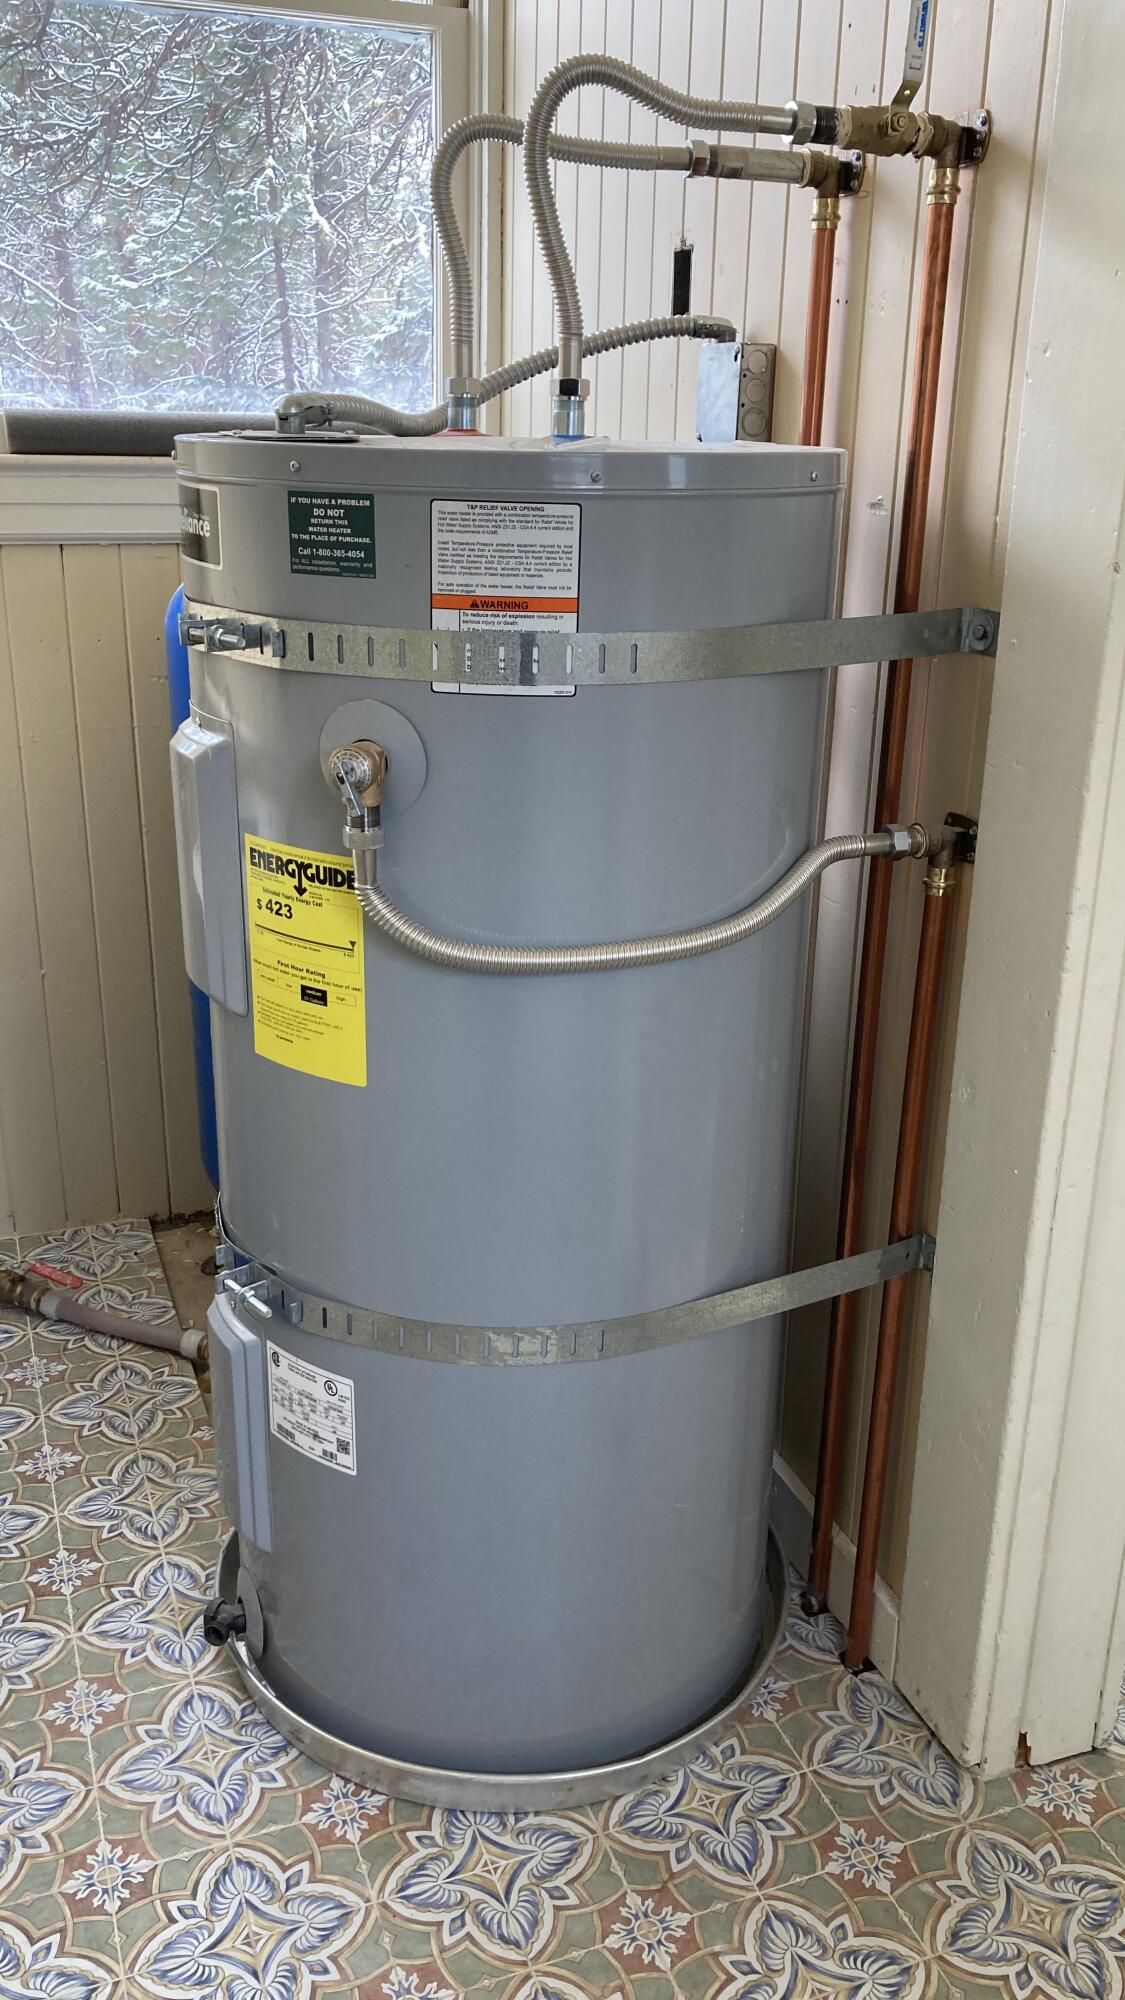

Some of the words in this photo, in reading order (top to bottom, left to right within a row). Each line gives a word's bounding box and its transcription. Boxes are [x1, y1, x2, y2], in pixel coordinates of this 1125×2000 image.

[313, 549, 364, 558] 1-800-365-4054
[480, 601, 528, 609] WARNING
[249, 846, 356, 891] ENERGYGUIDE
[296, 897, 311, 906] Energy
[257, 898, 262, 910] $
[266, 899, 293, 919] 423
[278, 960, 289, 968] First
[306, 968, 325, 978] Rating
